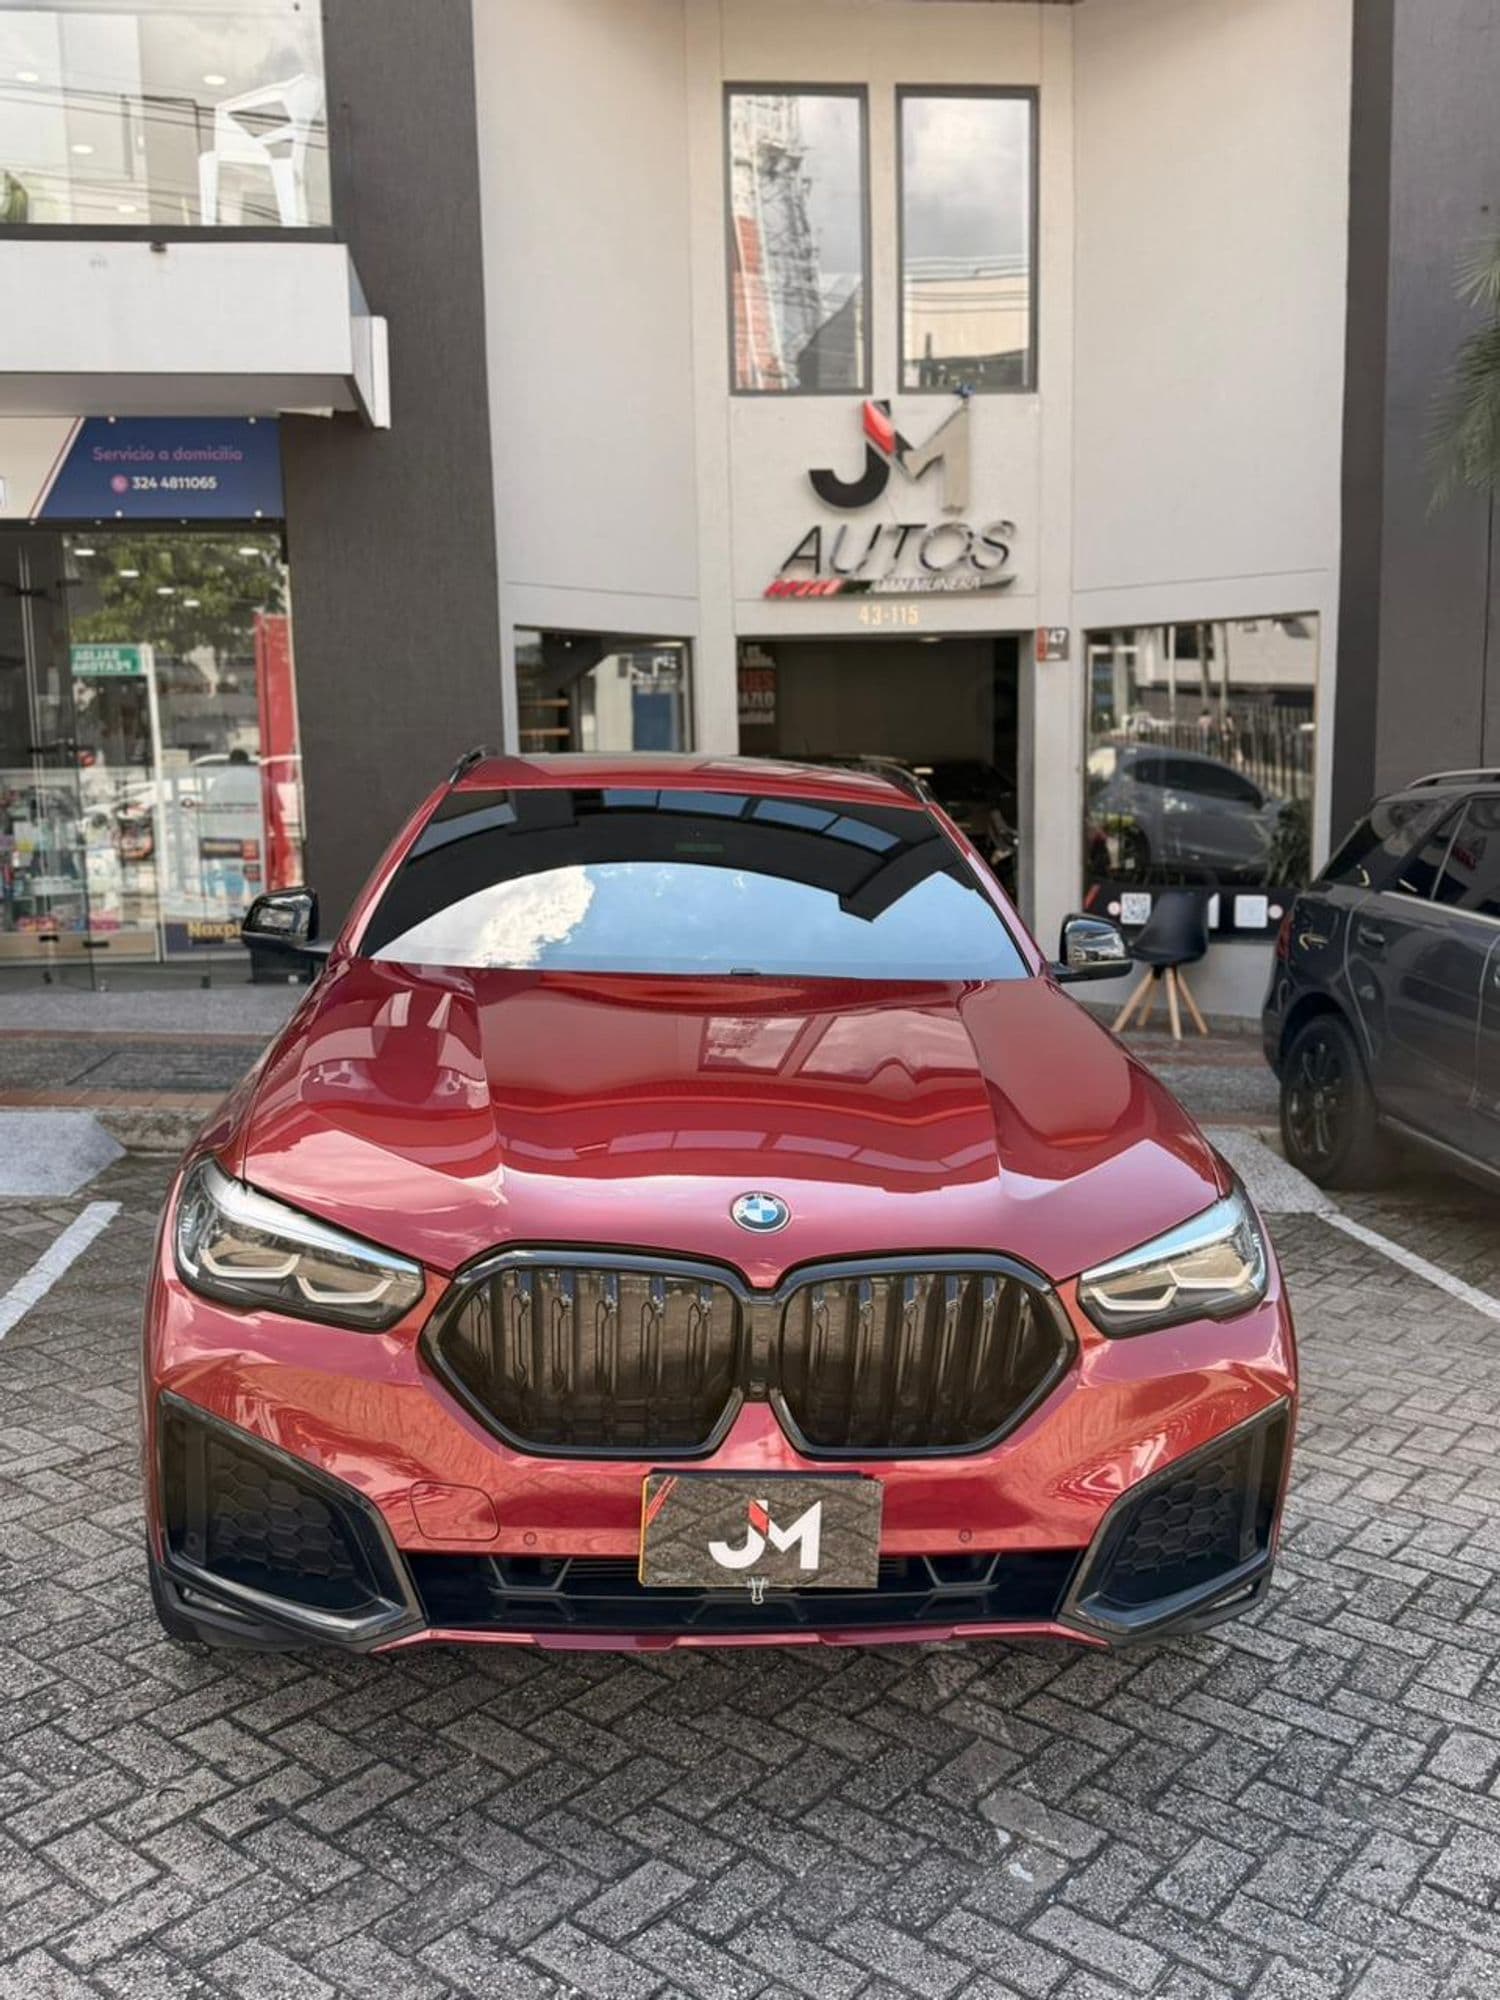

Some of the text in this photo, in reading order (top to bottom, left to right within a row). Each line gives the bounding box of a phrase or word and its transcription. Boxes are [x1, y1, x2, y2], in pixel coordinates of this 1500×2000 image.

[93, 445, 243, 461] Servicio a domicilio
[808, 400, 970, 514] JM
[132, 476, 218, 489] 324 4811065
[778, 519, 1017, 575] AUTOS
[858, 604, 920, 625] 43-115
[708, 1499, 822, 1570] JM
